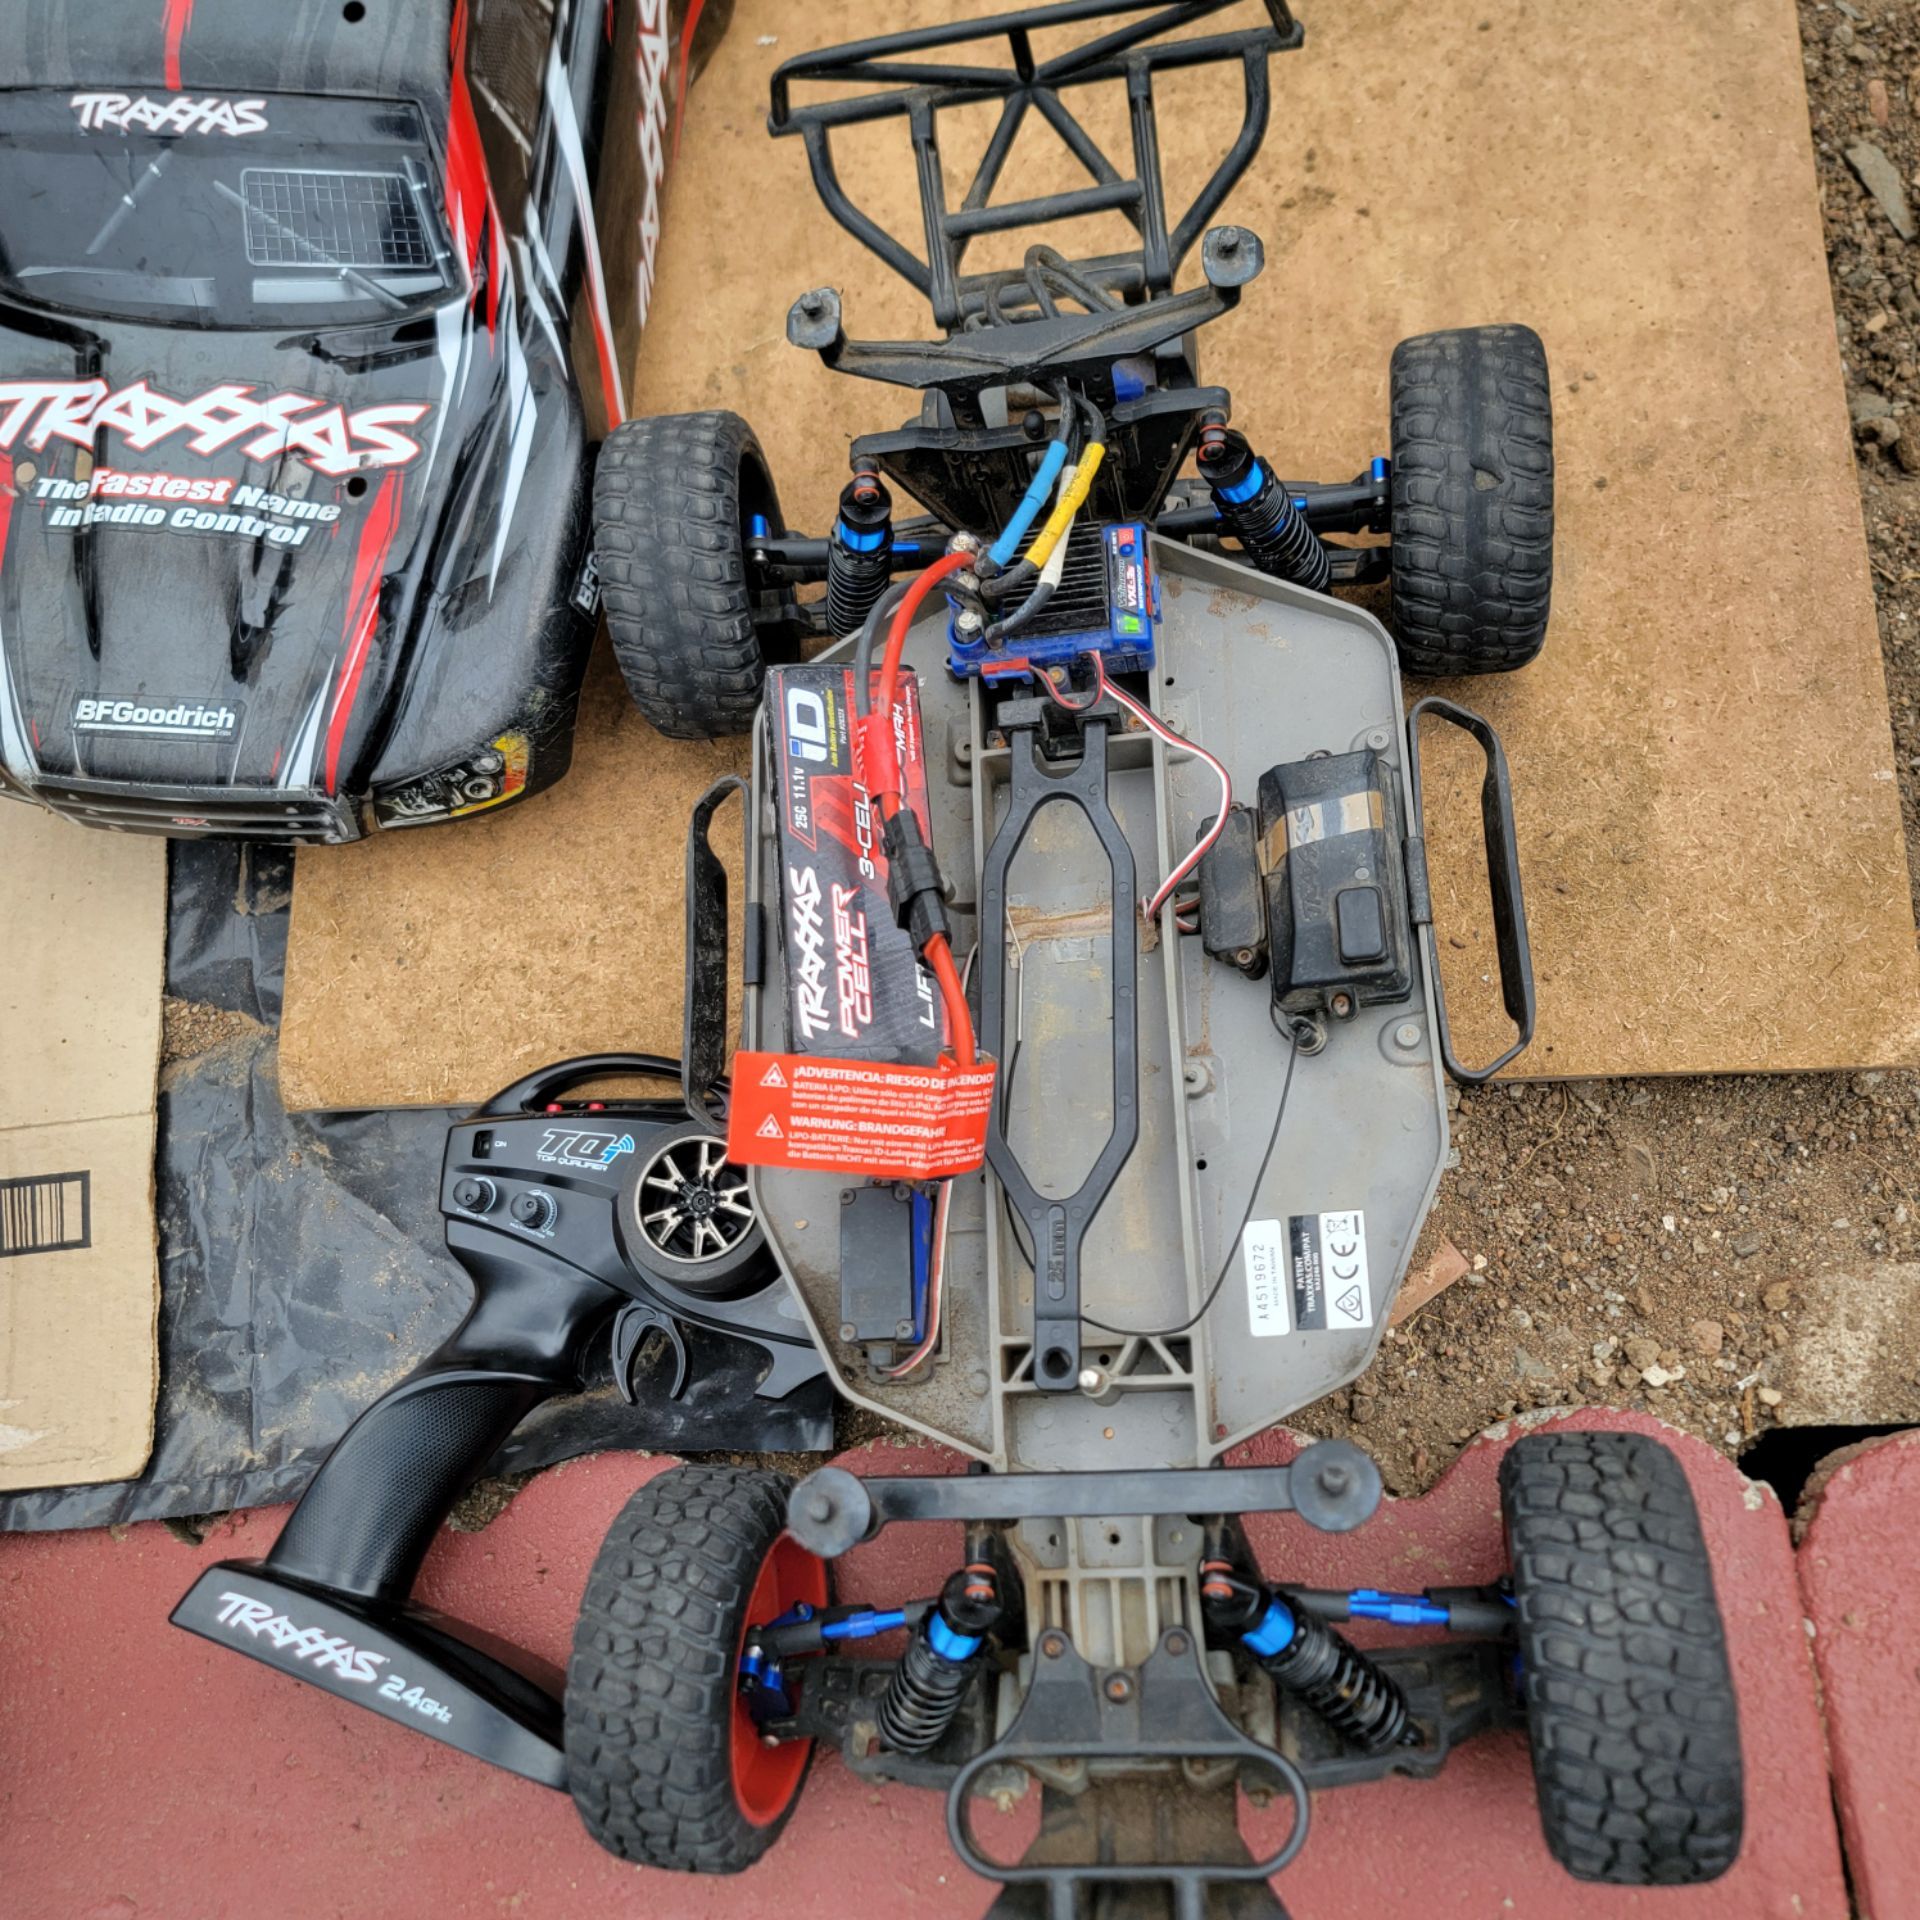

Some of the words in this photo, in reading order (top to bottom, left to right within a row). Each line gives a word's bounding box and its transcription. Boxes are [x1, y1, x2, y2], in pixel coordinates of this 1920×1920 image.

[71, 93, 269, 136] TRAXXAS
[0, 378, 430, 476] TRAXXAS
[36, 477, 90, 500] The
[90, 467, 236, 502] Fastest
[232, 485, 341, 522] Name
[49, 505, 83, 527] in
[169, 506, 309, 546] Control
[76, 699, 236, 729] BFGoodrich
[786, 686, 828, 762] iD
[793, 767, 806, 798] 11.1v
[794, 806, 807, 829] 25C
[789, 866, 831, 1039] TRAXXAS
[831, 881, 861, 1039] POWER
[850, 911, 873, 1025] CELL
[885, 1074, 929, 1088] RIESGO
[930, 1077, 946, 1090] DE
[790, 1115, 858, 1131] WARNUNG:
[536, 1153, 556, 1163] TOP
[1295, 1255, 1305, 1290] PATENT
[214, 1590, 387, 1684] TRAXXAS
